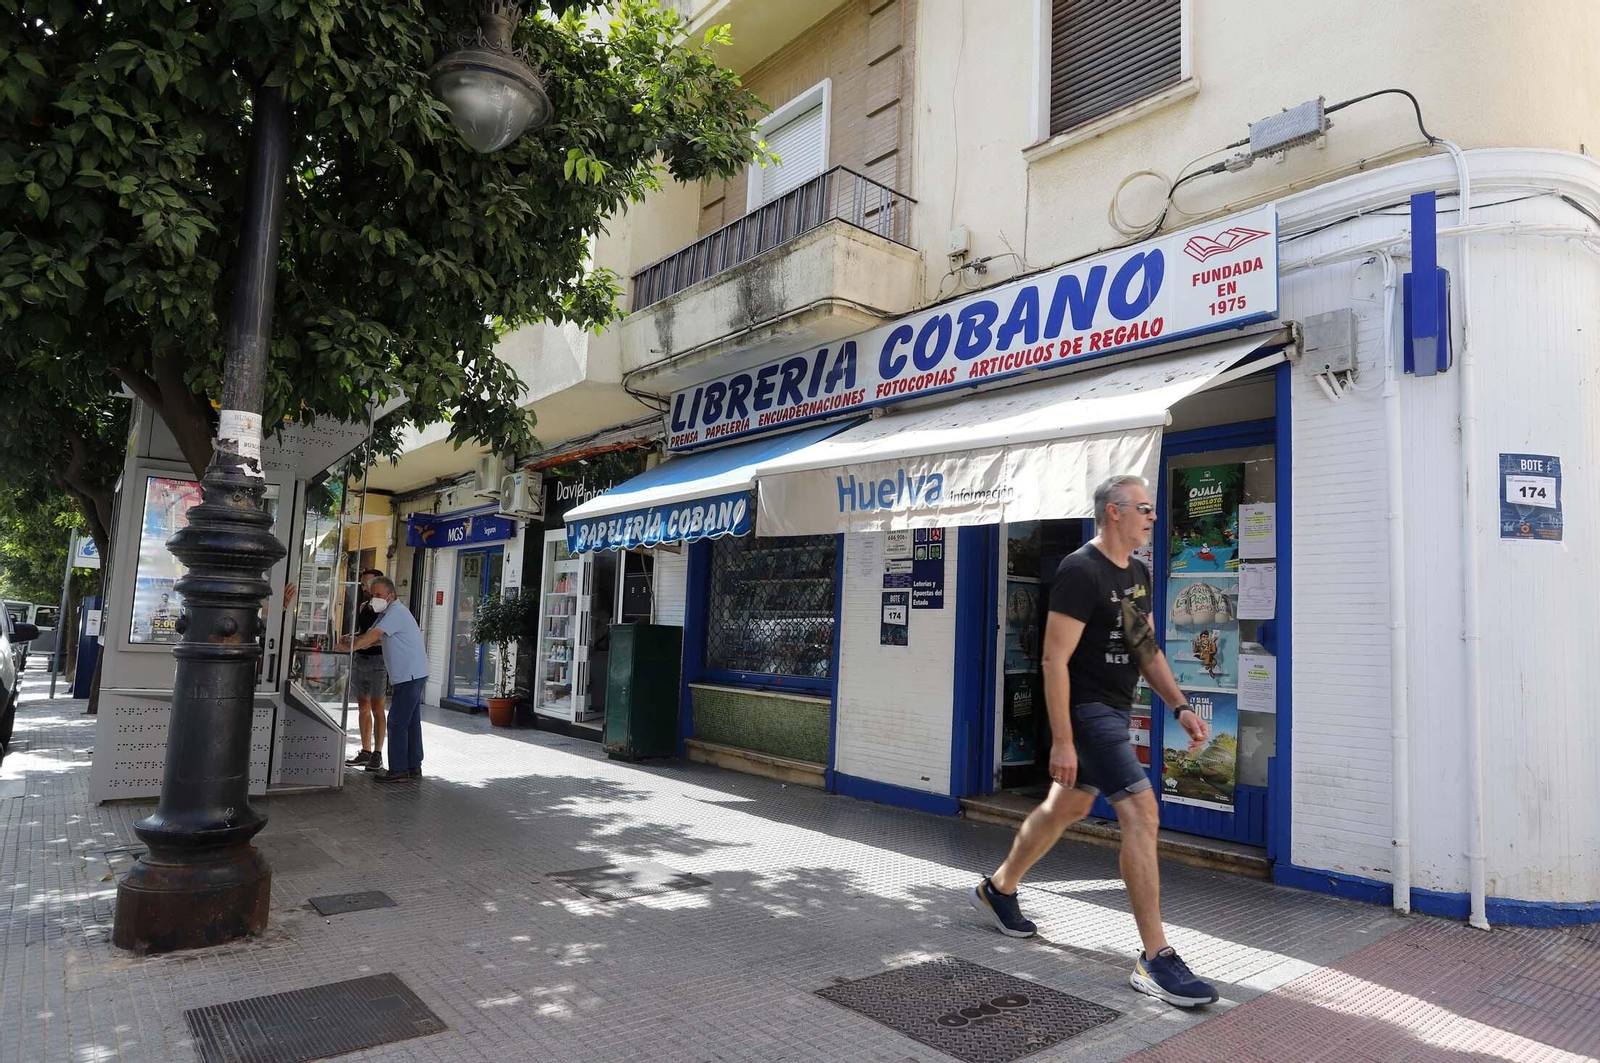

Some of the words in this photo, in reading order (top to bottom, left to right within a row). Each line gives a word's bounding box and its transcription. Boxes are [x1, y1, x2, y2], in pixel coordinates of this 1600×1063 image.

[1192, 256, 1264, 287] FUNDADA
[1217, 281, 1237, 298] EN
[1208, 295, 1247, 316] 1975
[670, 341, 857, 433] LIBRERIA
[878, 248, 1165, 380] COBANO
[670, 430, 698, 448] PRENSA
[705, 418, 750, 440] PAPELERIA
[758, 388, 866, 426] ENCUADERNACIONES
[876, 366, 957, 399] FOTOCOPIAS
[968, 342, 1055, 379] ARTICULOS
[1059, 336, 1084, 358] DE
[1089, 316, 1164, 351] REGALO
[1520, 459, 1543, 472] BOTE
[557, 475, 585, 502] David
[836, 468, 944, 513] Huelva
[950, 485, 1014, 504] información
[1189, 481, 1222, 498] OJALÁ
[1519, 486, 1547, 499] 174
[579, 507, 662, 547] PAPELERÍA
[667, 498, 747, 535] COBANO
[448, 526, 464, 542] MGS
[506, 552, 511, 565] 4
[889, 594, 901, 603] BOTE
[934, 588, 943, 596] del
[888, 612, 902, 620] 174
